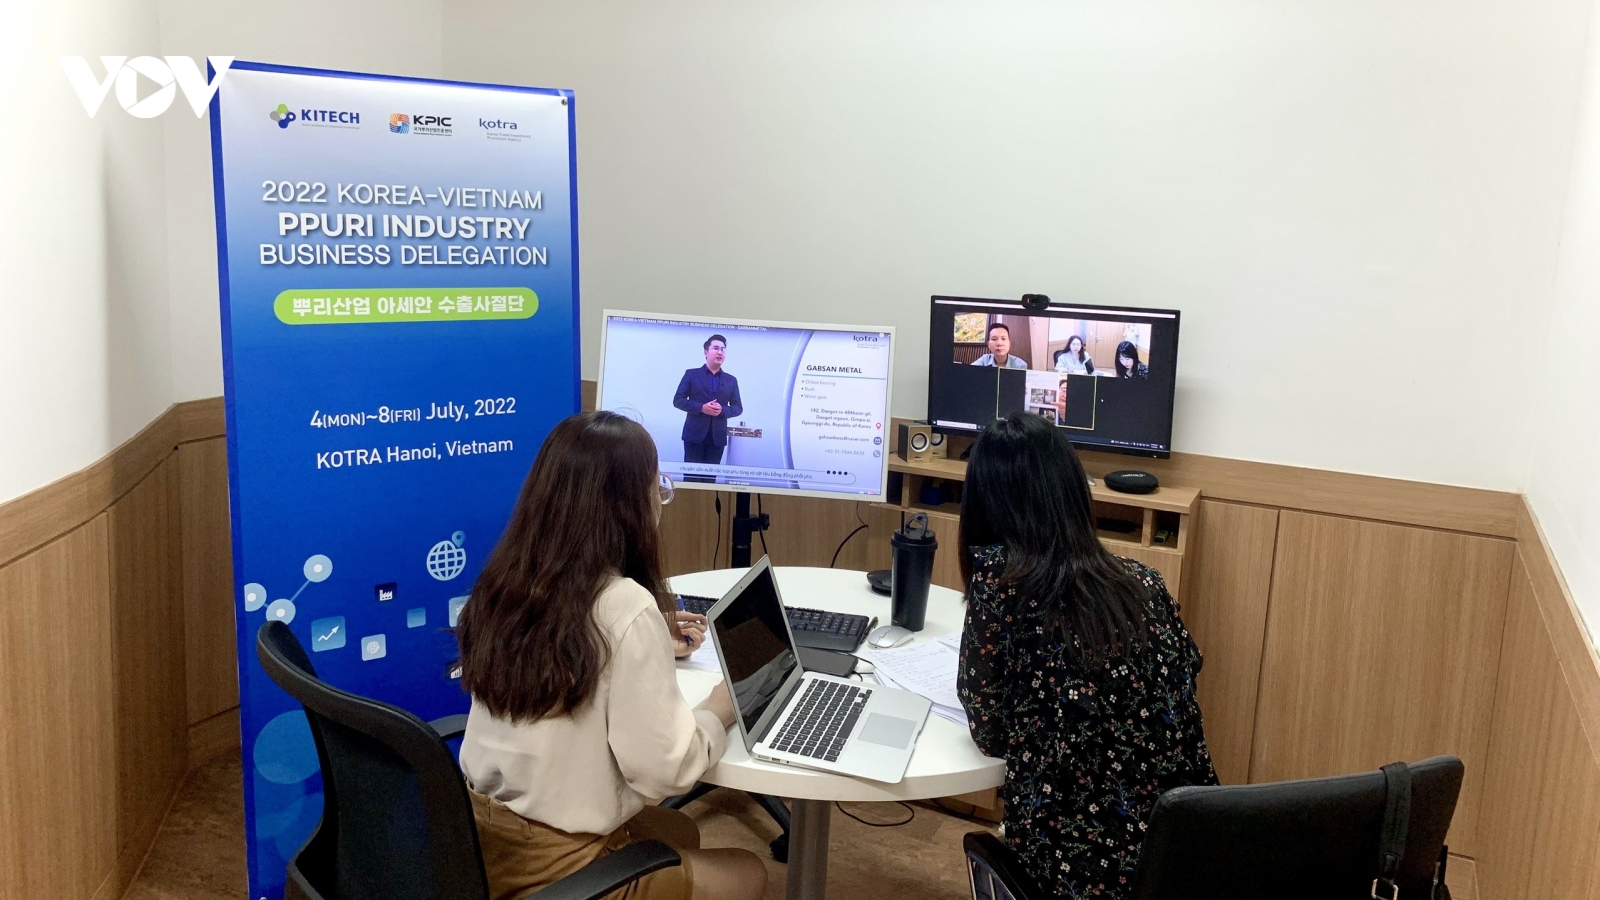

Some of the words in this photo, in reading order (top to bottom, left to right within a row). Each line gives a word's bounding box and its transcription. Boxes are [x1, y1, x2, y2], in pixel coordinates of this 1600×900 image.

[301, 109, 360, 124] KITECH
[413, 115, 452, 127] KPIC
[479, 118, 518, 130] kotra
[262, 180, 327, 203] 2022
[338, 183, 542, 210] KOREA-VIETNAM
[279, 212, 374, 237] PPURI
[383, 214, 531, 240] INDUSTRY
[260, 243, 391, 265] BUSINESS
[401, 244, 547, 266] DELEGATION
[292, 297, 371, 317] 뿌리산업
[377, 296, 433, 315] 아세안
[438, 295, 525, 313] 수출사절단
[806, 364, 837, 373] GABSAN
[839, 366, 863, 374] METAL
[310, 405, 421, 429] 4(MON)~8(FRI)
[426, 401, 469, 422] July,
[474, 397, 517, 417] 2022
[317, 448, 383, 470] KOTRA
[387, 442, 442, 463] Hanoi,
[445, 439, 514, 457] Vietnam
